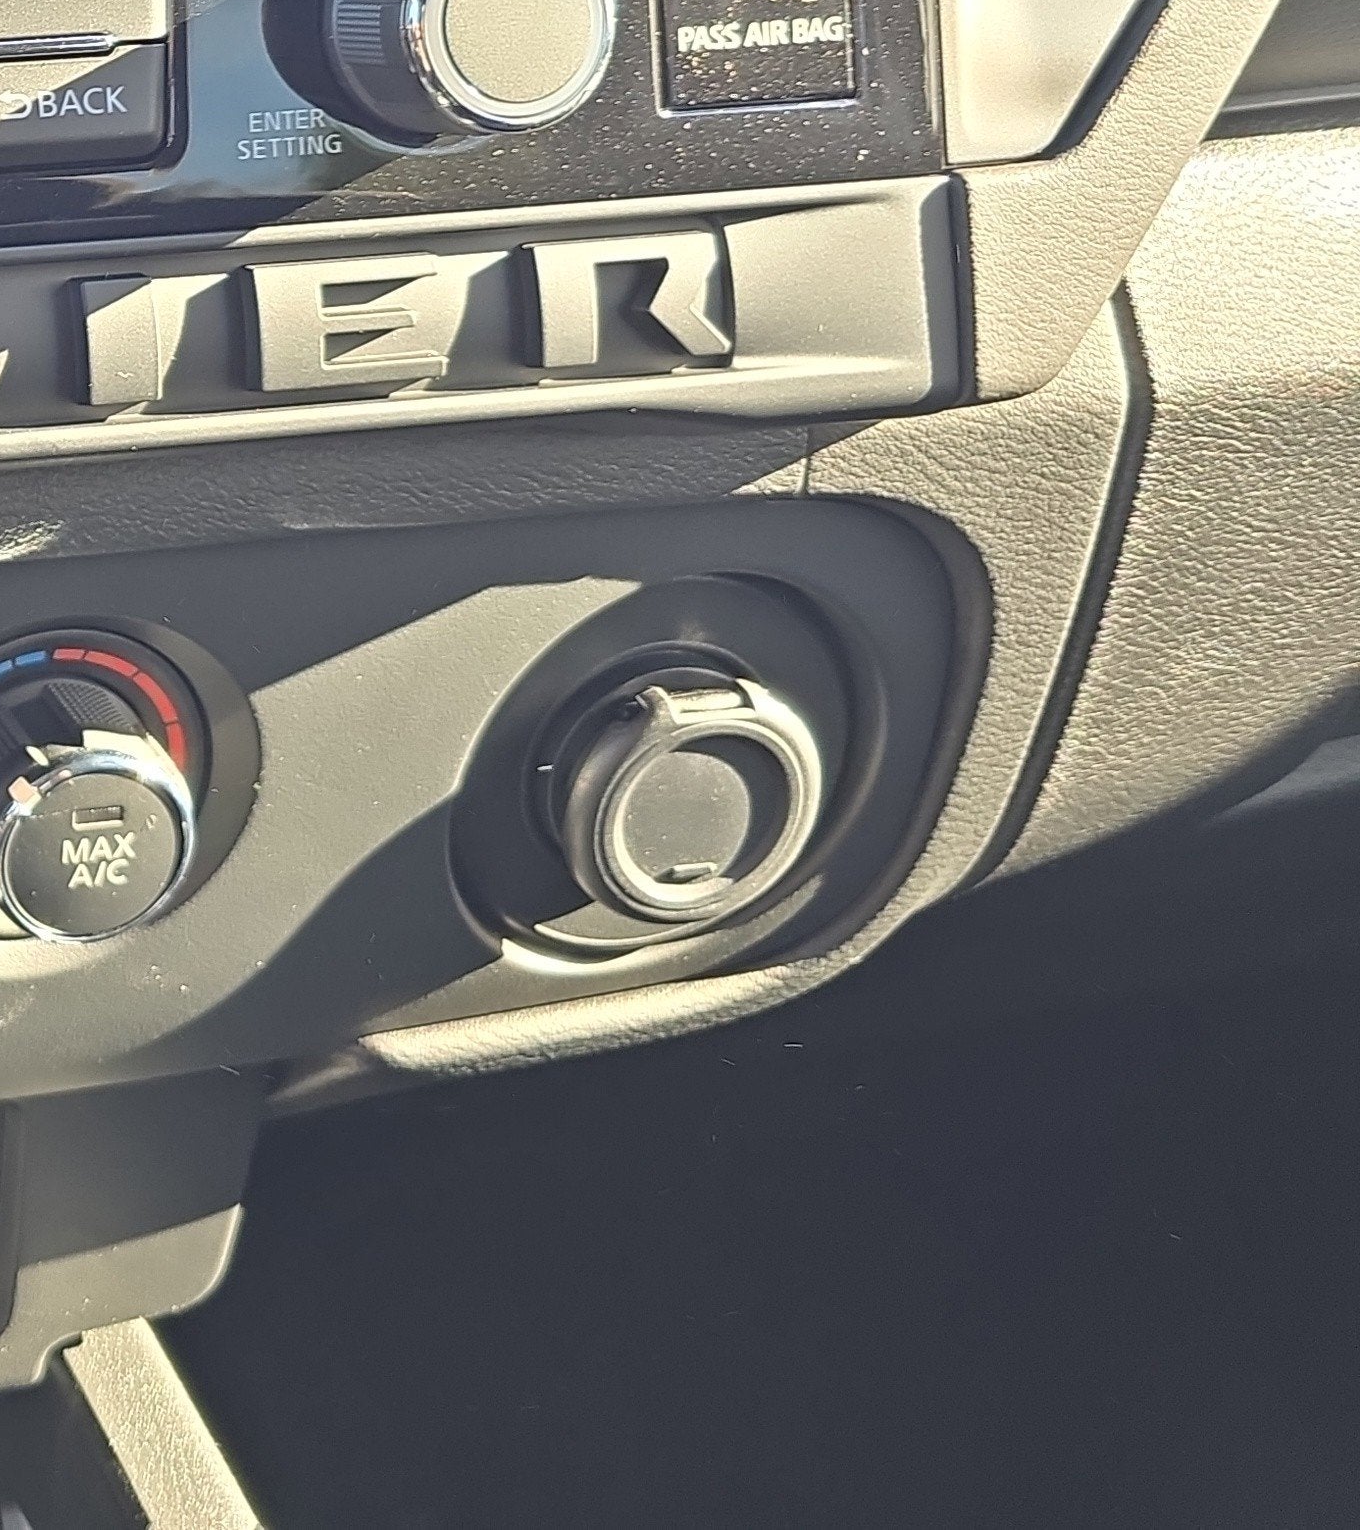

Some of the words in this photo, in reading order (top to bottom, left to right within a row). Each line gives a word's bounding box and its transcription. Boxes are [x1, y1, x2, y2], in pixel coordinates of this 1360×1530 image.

[678, 21, 741, 52] PASS
[743, 19, 789, 47] AIR
[792, 15, 845, 43] BAG
[39, 86, 127, 118] BACK
[248, 108, 326, 133] ENTER
[237, 133, 342, 160] SETTING
[61, 832, 137, 866] MAX
[68, 858, 130, 889] A/C
